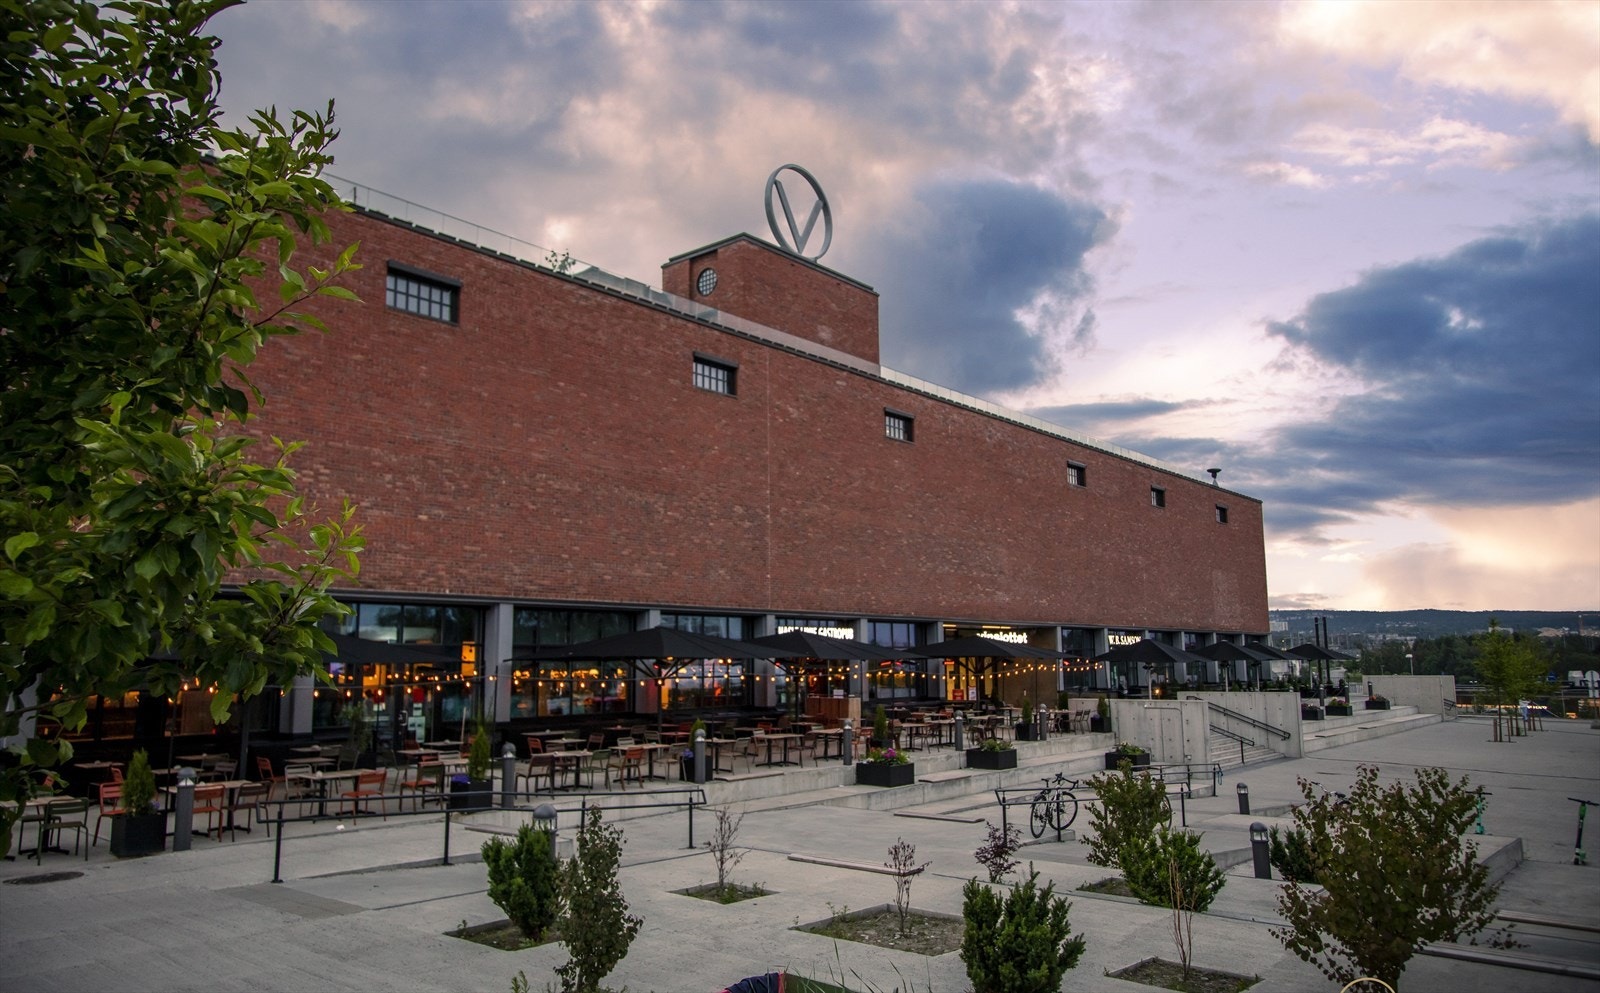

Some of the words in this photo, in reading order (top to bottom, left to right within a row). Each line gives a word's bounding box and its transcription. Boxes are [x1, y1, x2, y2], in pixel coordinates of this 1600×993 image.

[774, 179, 824, 254] V
[777, 626, 799, 635] HASL
[818, 627, 854, 640] GASTROPUB
